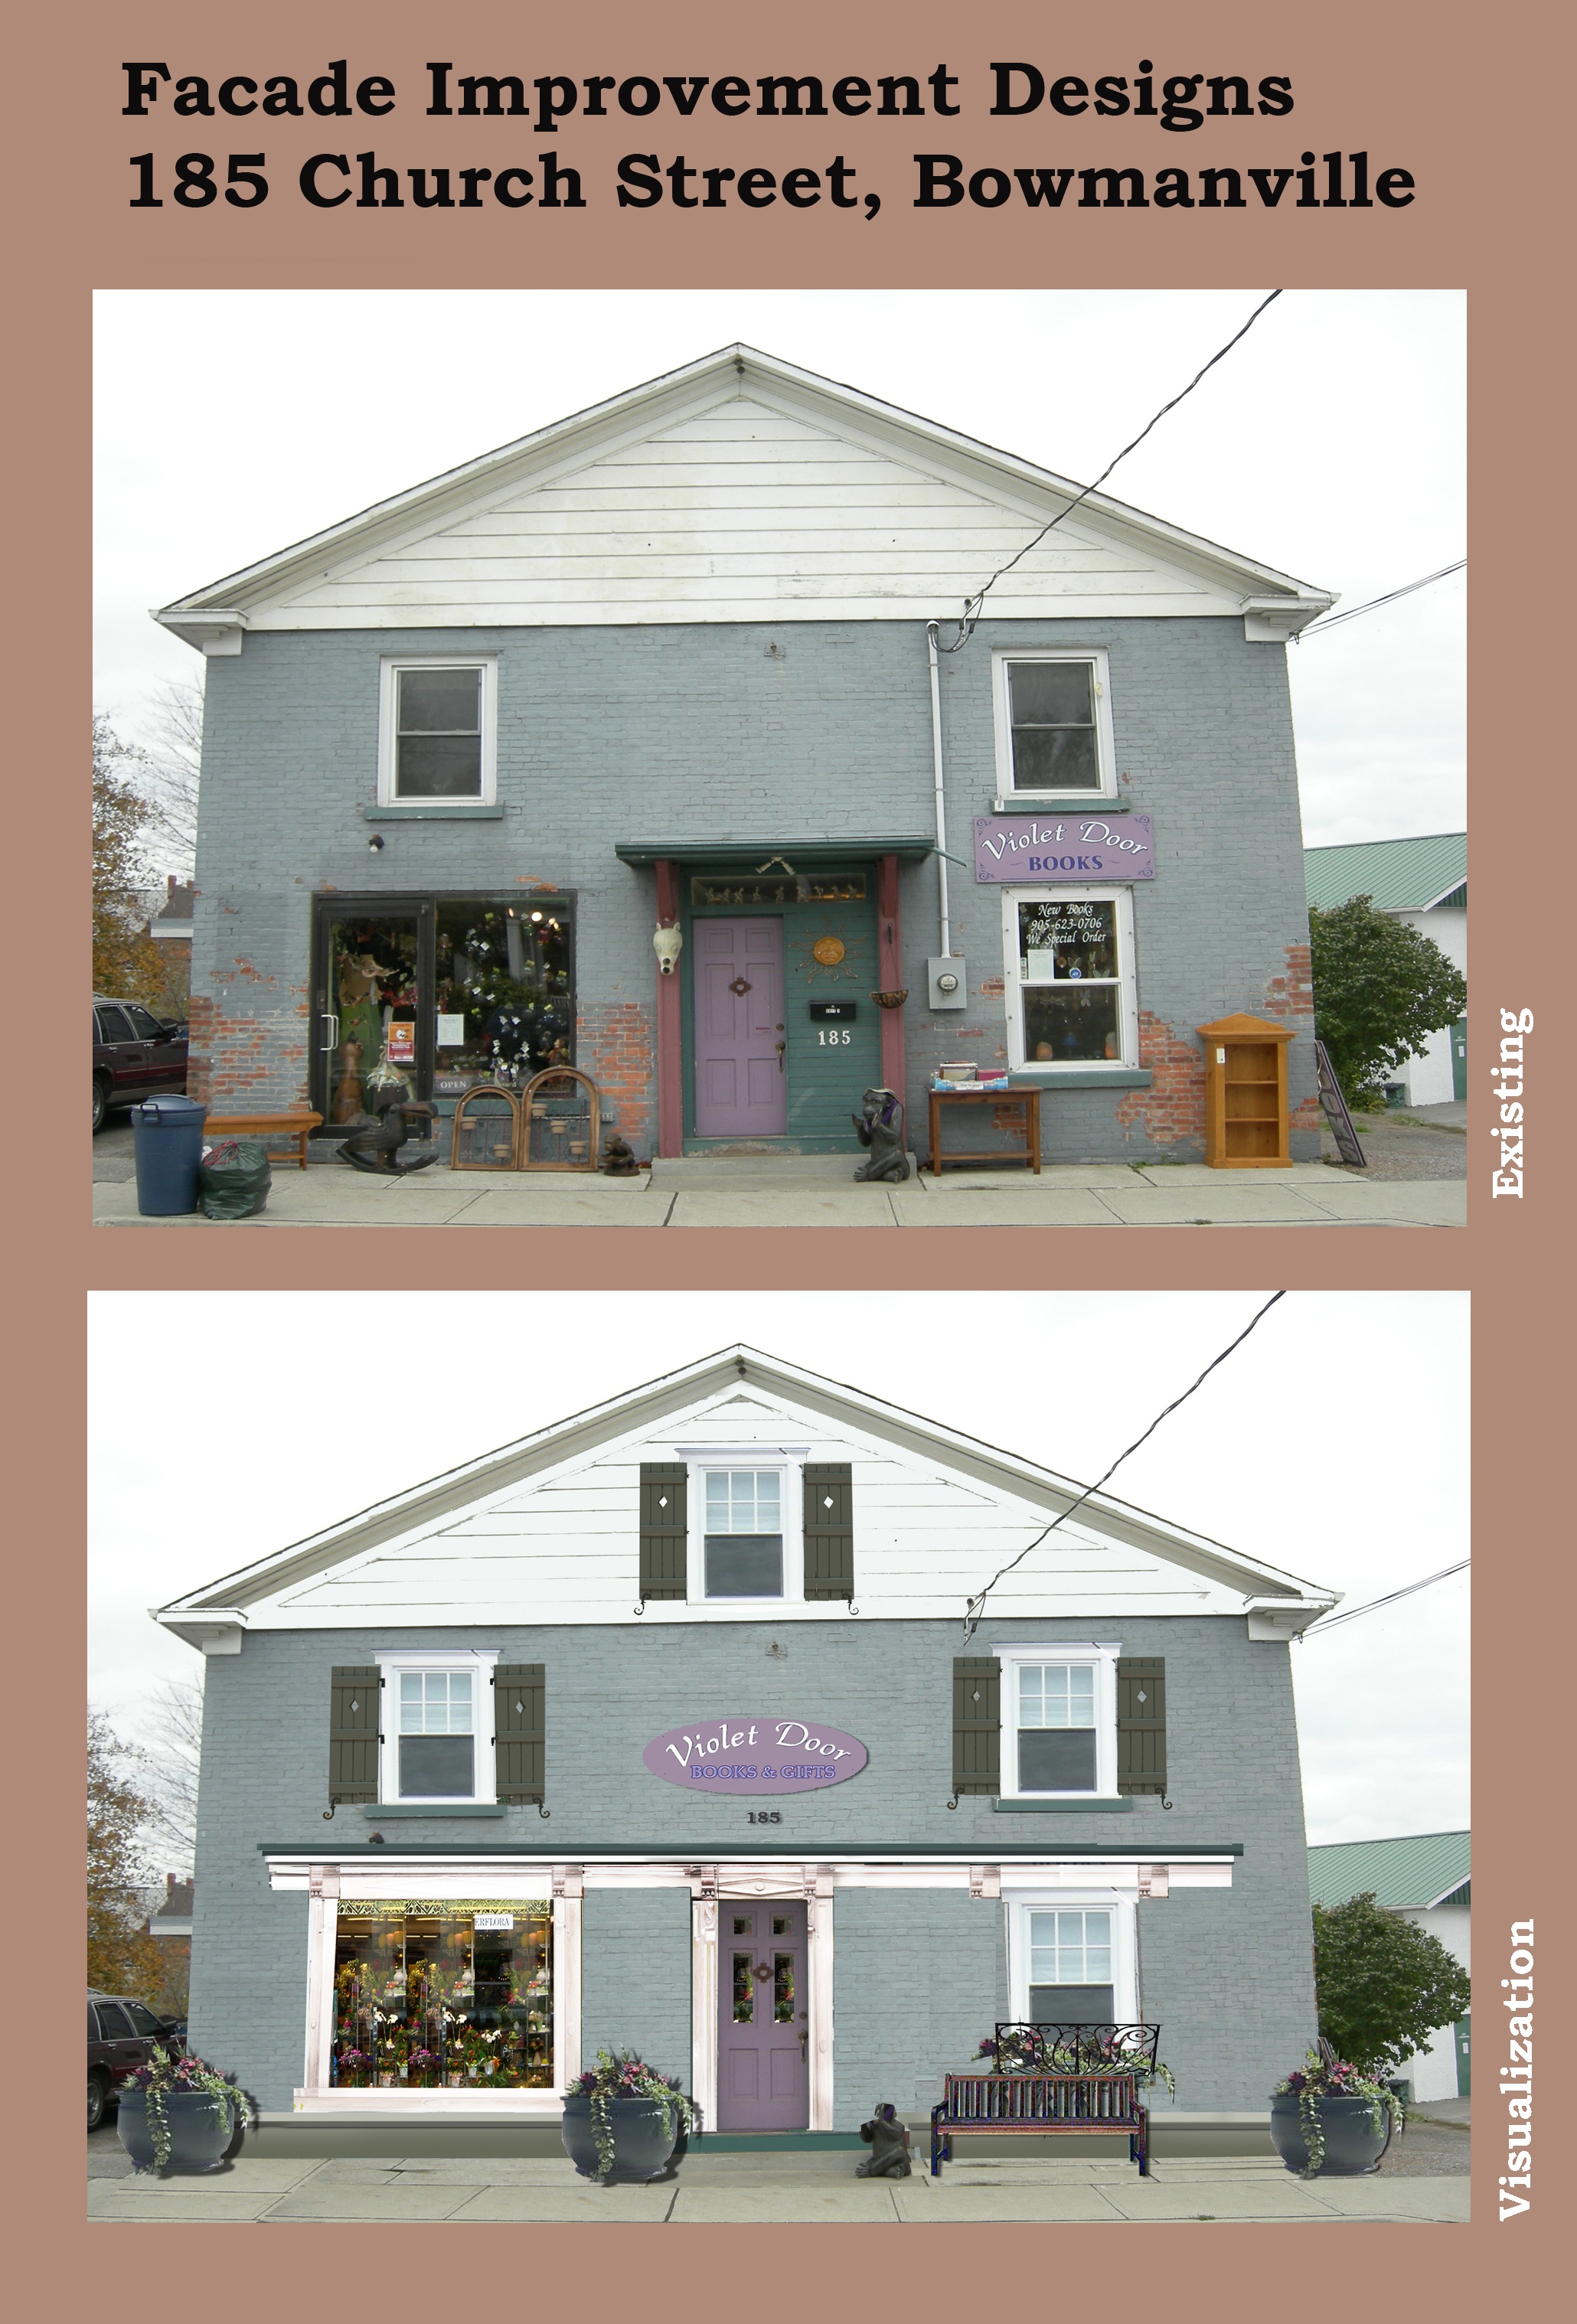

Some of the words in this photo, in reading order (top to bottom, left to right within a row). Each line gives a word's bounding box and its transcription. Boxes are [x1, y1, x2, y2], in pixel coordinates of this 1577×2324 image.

[981, 822, 1066, 860] Violet
[1079, 821, 1148, 855] Door
[1029, 855, 1103, 871] BOOKS
[1038, 903, 1062, 918] New
[1066, 902, 1094, 917] Books
[1030, 918, 1102, 932] 905-623-0706
[1026, 933, 1041, 945] We
[1045, 931, 1078, 948] Special
[1082, 930, 1107, 943] Order
[818, 1030, 851, 1046] 185
[440, 1081, 466, 1089] OPEN
[665, 1724, 759, 1767] Violet
[775, 1722, 851, 1761] Door
[691, 1765, 758, 1779] BOOKS
[762, 1765, 776, 1779] &
[780, 1765, 836, 1779] GIFTS
[746, 1811, 781, 1823] 185
